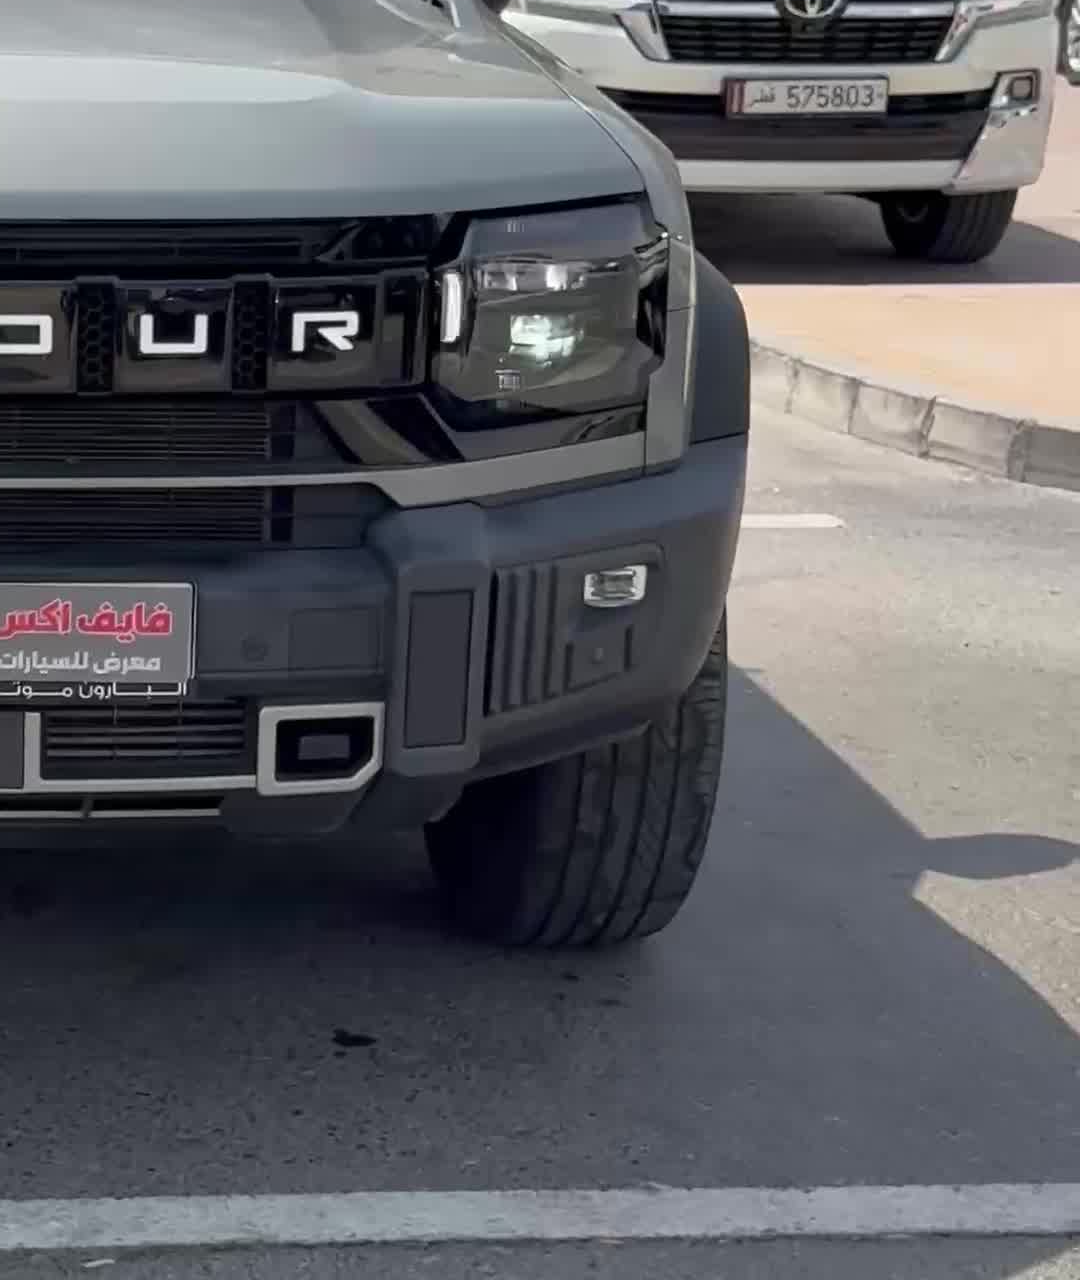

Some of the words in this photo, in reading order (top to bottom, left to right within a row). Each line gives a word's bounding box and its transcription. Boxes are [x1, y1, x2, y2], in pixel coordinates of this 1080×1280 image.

[786, 84, 874, 110] 575803
[76, 601, 173, 644] فايف
[92, 651, 161, 674] معرض
